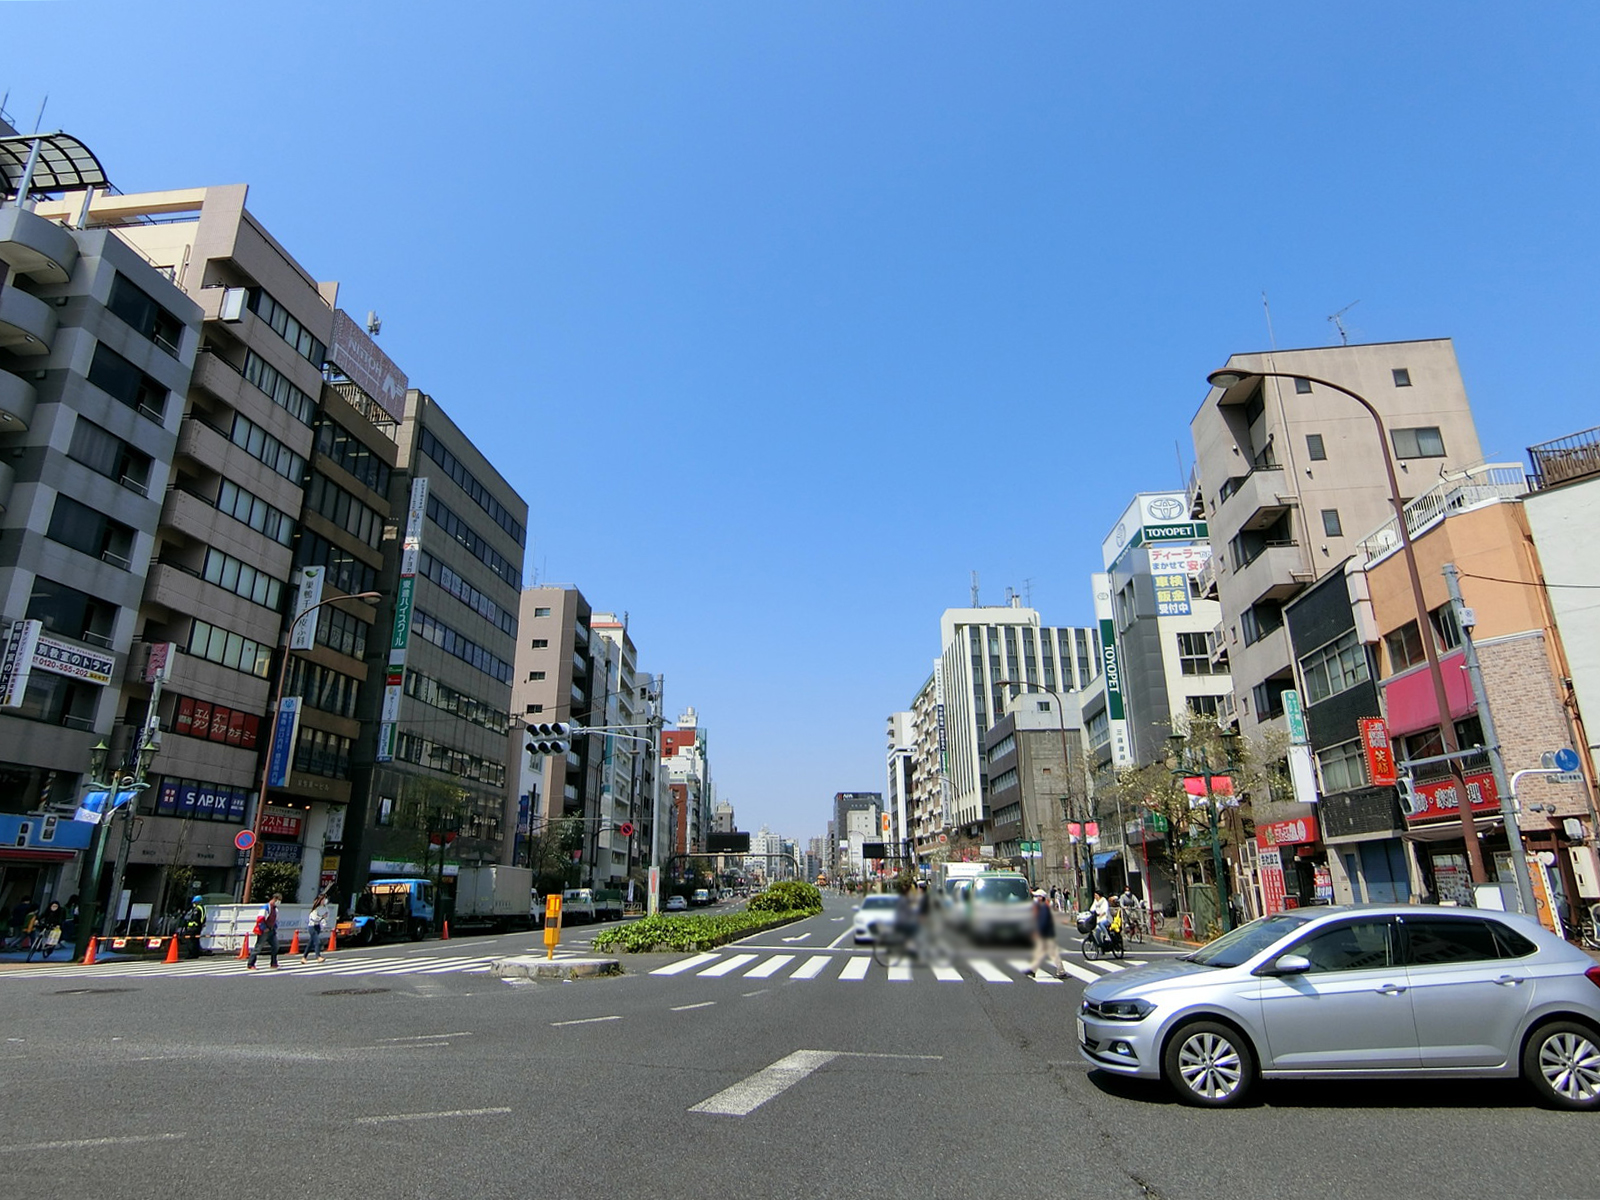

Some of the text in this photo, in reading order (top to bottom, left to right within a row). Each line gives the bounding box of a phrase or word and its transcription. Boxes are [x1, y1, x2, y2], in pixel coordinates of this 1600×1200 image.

[1146, 526, 1193, 538] TOYOPET
[1151, 549, 1201, 561] ディーラー
[1155, 575, 1184, 588] 車検
[394, 580, 411, 647] 東進ハイスクール
[1158, 602, 1189, 614] 受付中
[39, 657, 88, 677] 0120-555-202
[1104, 643, 1119, 694] TOYOPET
[185, 792, 227, 809] SAPIX
